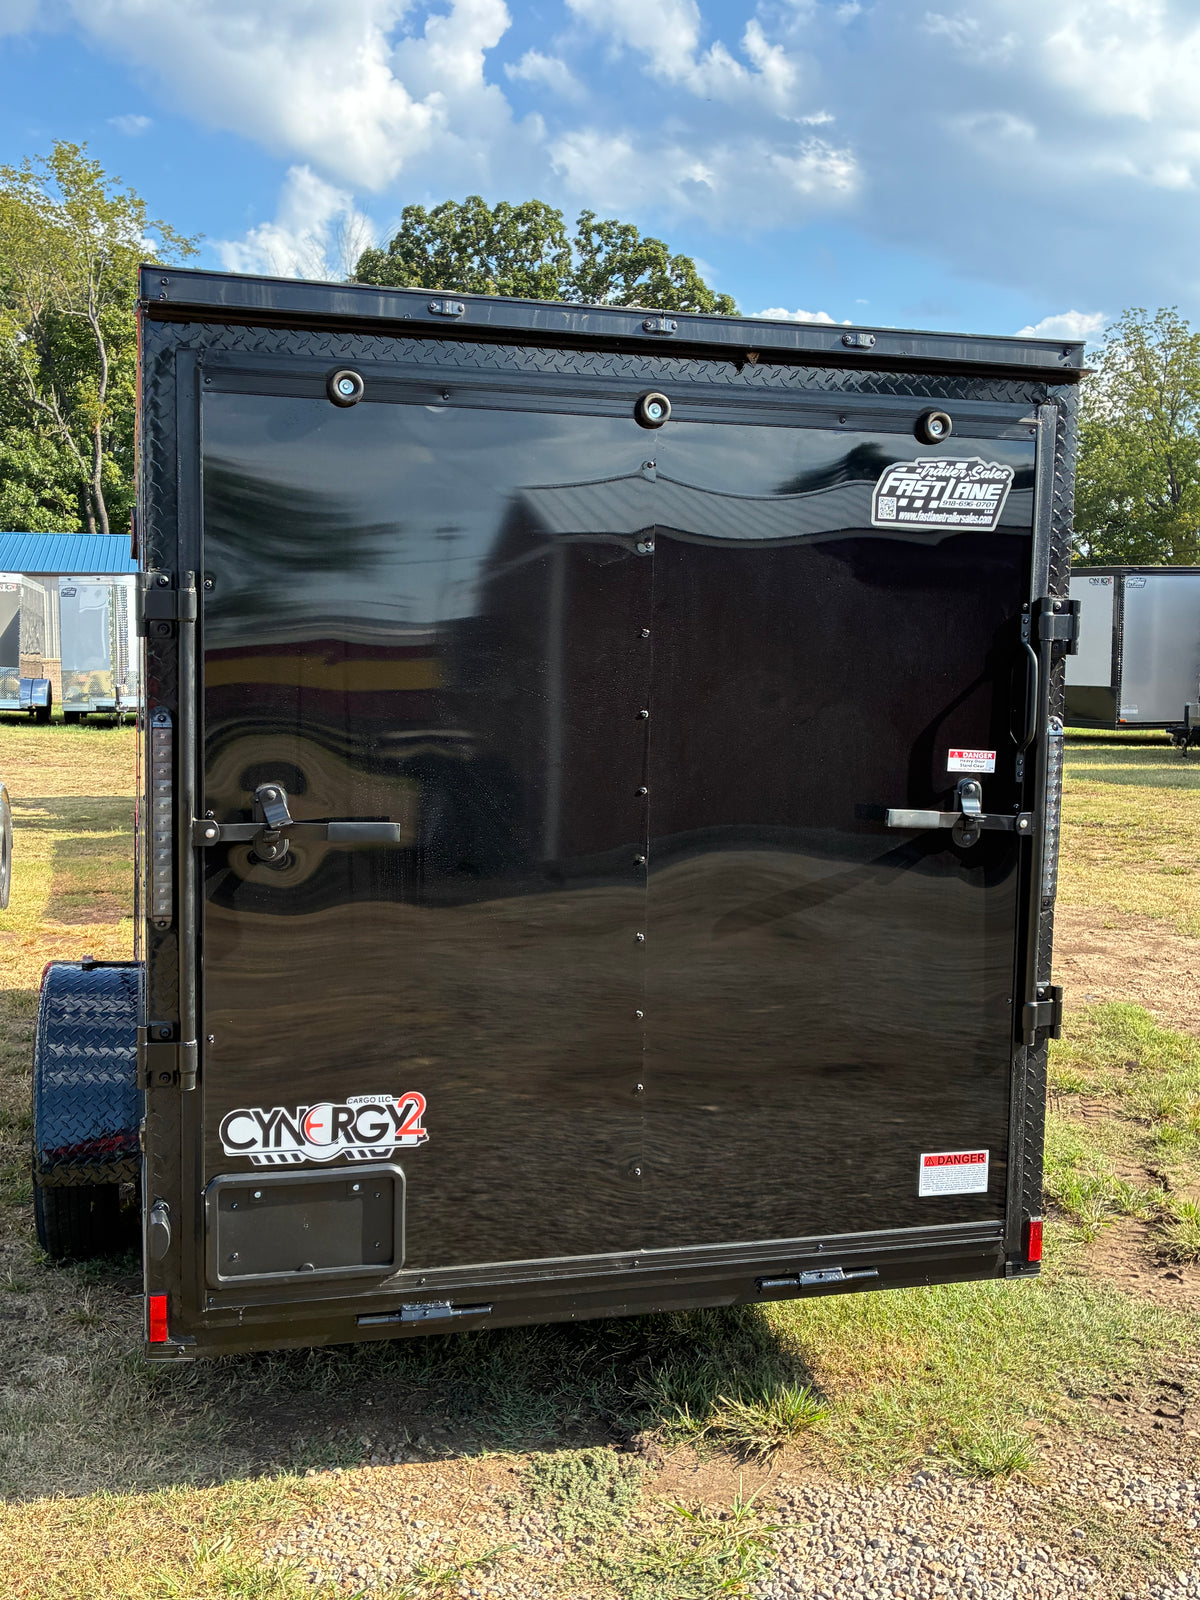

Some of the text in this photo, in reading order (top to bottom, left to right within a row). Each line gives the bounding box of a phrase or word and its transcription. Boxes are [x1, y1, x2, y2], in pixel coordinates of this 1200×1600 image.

[919, 462, 1009, 480] Trailer Sales
[941, 500, 996, 508] 918-696-0701
[898, 510, 993, 524] www.fastlanetrailersales.com
[962, 751, 993, 760] DANGER
[347, 1095, 391, 1105] CARGO LLC
[937, 1152, 985, 1165] DANGER
